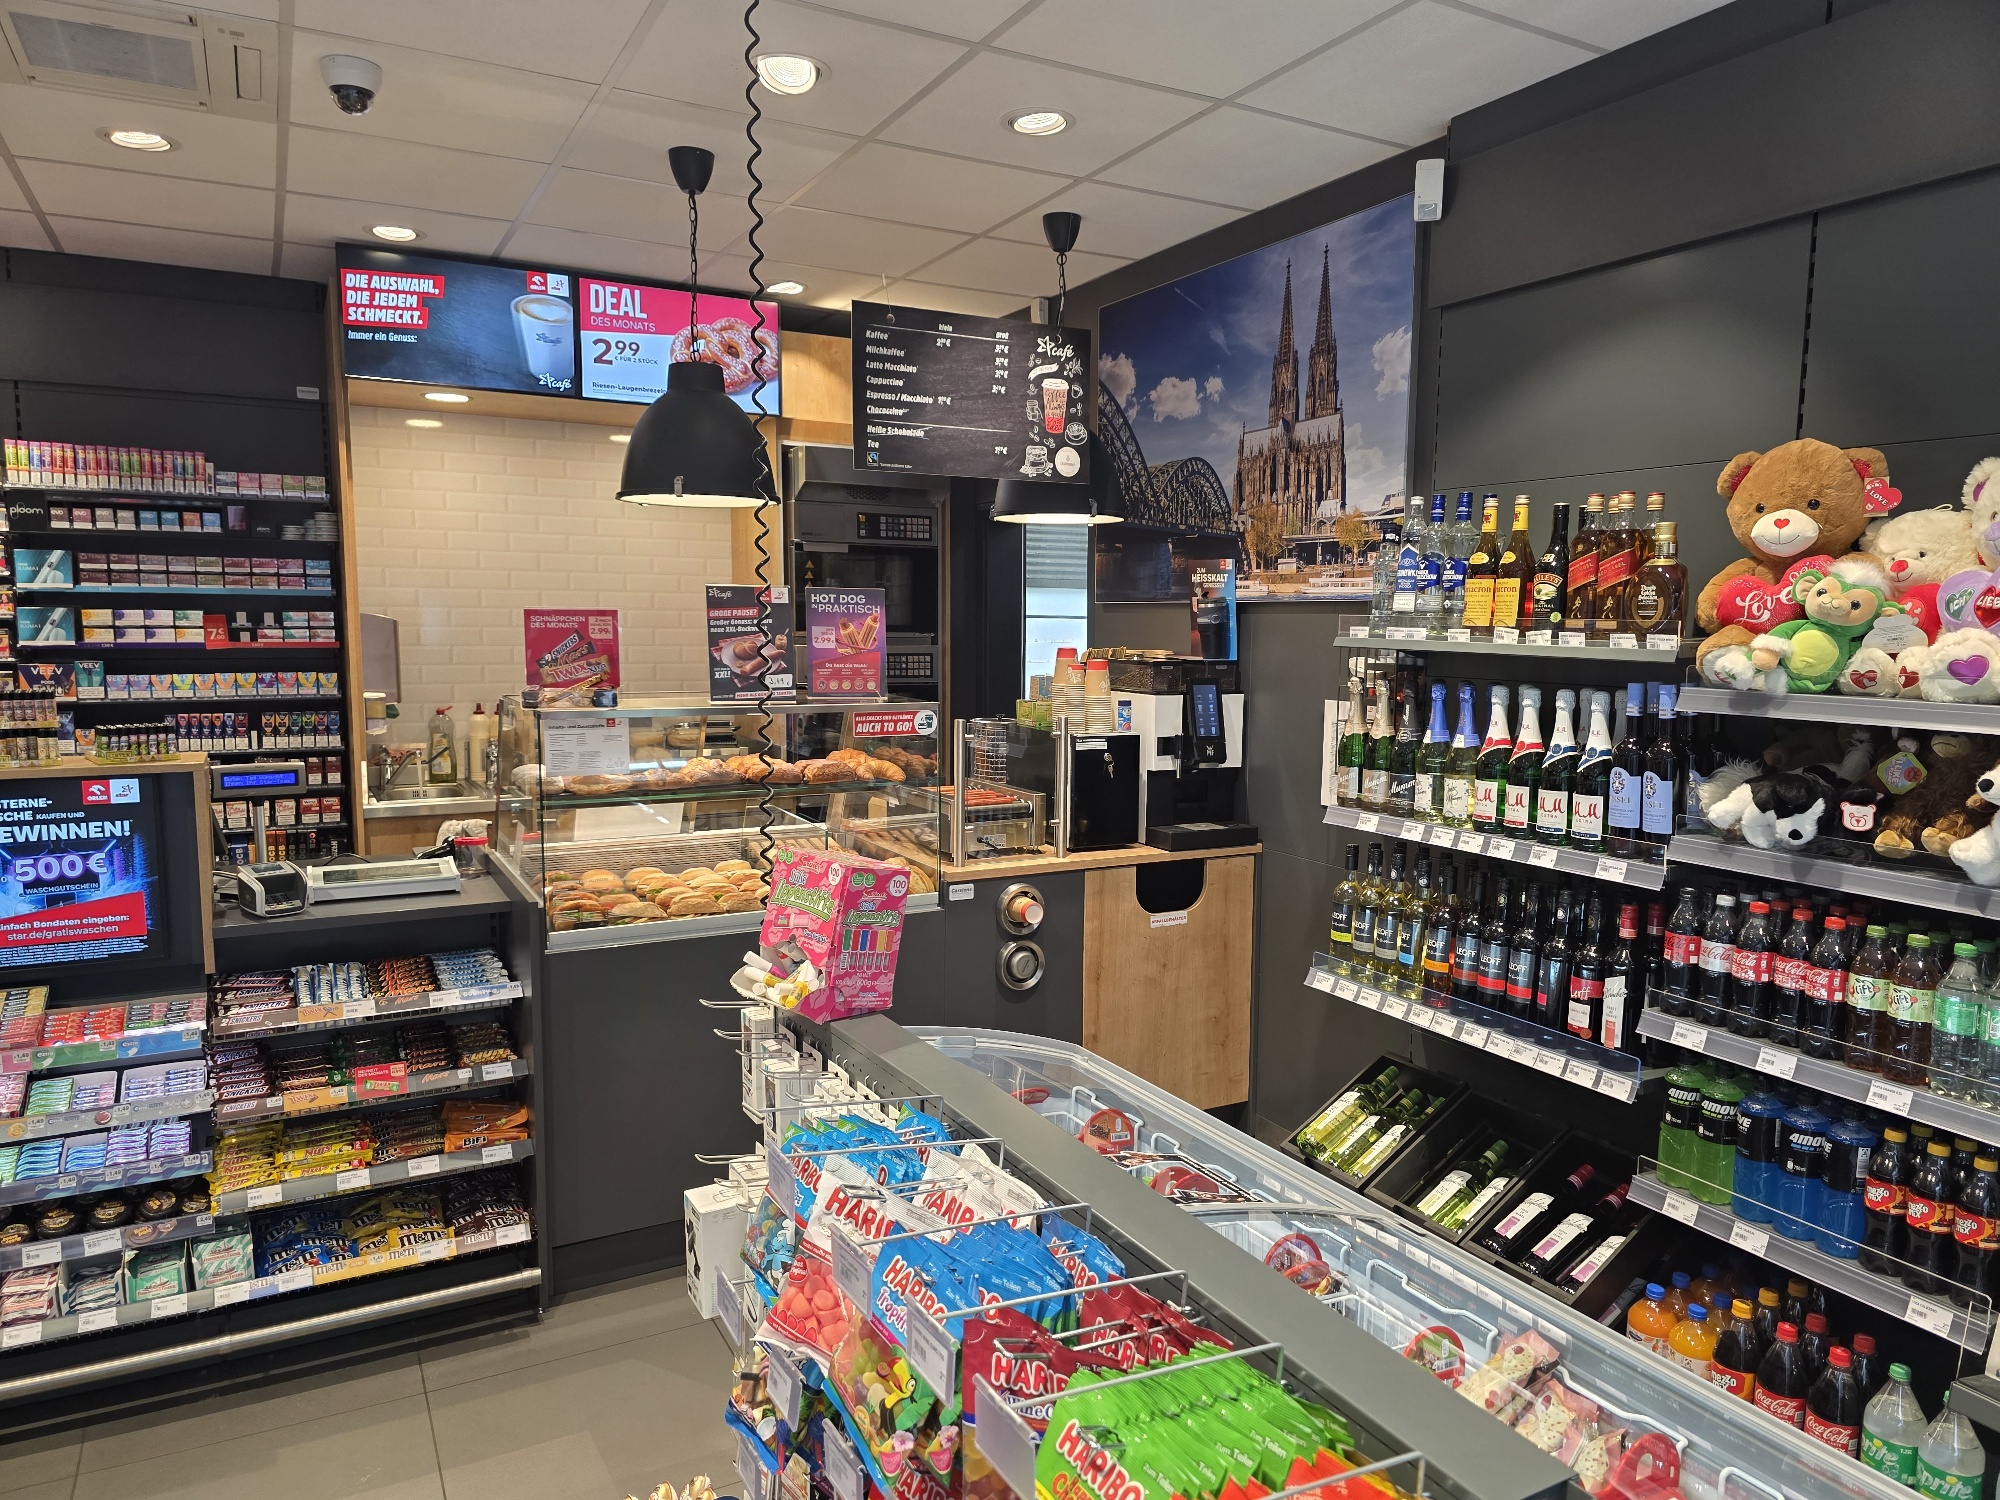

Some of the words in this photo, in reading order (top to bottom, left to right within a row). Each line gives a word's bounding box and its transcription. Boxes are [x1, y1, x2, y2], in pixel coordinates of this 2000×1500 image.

[346, 274, 368, 288] DIE
[371, 275, 440, 295] AUSWAHL,
[346, 290, 369, 305] DIE
[373, 292, 417, 308] JEDEM
[590, 284, 647, 319] DEAL
[348, 307, 423, 324] SCHMECKT.
[591, 316, 610, 326] DES
[613, 319, 655, 332] MONATS
[348, 330, 373, 341] Immer
[374, 332, 386, 341] ein
[389, 333, 417, 343] Genuss:
[866, 345, 904, 357] Milchkaffee
[1051, 344, 1074, 361] café
[638, 357, 658, 365] STÜCK
[866, 360, 883, 370] Latte
[884, 362, 917, 373] Macchiato
[551, 378, 572, 391] café
[866, 375, 903, 387] Cappuccino
[866, 390, 895, 400] Espresso
[901, 394, 933, 404] Macchiato
[867, 425, 886, 434] Heiße
[868, 440, 879, 449] Tee
[1868, 490, 1890, 507] LOVE
[10, 502, 44, 519] ploom
[1191, 574, 1228, 582] HEISSKALT
[718, 591, 732, 599] café
[811, 594, 836, 603] HOT
[840, 594, 866, 603] DOG
[818, 604, 880, 614] PRAKTISCH
[1734, 585, 1795, 623] Love
[1950, 596, 1966, 613] ICH
[553, 635, 578, 658] SNICKERS
[856, 723, 881, 733] AUCH
[883, 723, 895, 732] TO
[896, 722, 912, 731] GO!
[1390, 779, 1416, 794] Mumm
[236, 848, 245, 864] OCB
[25, 882, 98, 894] WASCHGUTSCHEIN
[892, 879, 906, 889] 100
[770, 879, 836, 915] Lippenstifte
[34, 918, 81, 928] Bondaten
[83, 915, 129, 924] eingeben:
[7, 924, 119, 941] star.de/gratiswaschen
[1427, 939, 1445, 948] LEOFF
[1457, 947, 1477, 957] LEOFF
[1480, 953, 1501, 965] LEOFF
[1509, 961, 1527, 973] LEOFF
[239, 985, 283, 996] SNICKERS
[463, 989, 489, 997] BOUNTY
[395, 995, 419, 1005] Mars
[229, 1014, 262, 1025] SNICKERS
[422, 1071, 449, 1083] Mars
[224, 1087, 266, 1097] SNICKERS
[1701, 1099, 1739, 1115] 4mov
[463, 1136, 487, 1147] BiFi
[304, 1145, 332, 1157] NUTS
[1867, 1185, 1889, 1197] mezzo
[1868, 1192, 1881, 1202] mix
[1955, 1216, 1977, 1229] mezzo
[1956, 1225, 1970, 1235] mix
[398, 1229, 447, 1248] m&m's
[465, 1231, 494, 1244] m&m's
[316, 1261, 347, 1275] m&m's
[991, 1276, 1002, 1285] Zum
[1003, 1279, 1022, 1293] Teilen
[1755, 1388, 1798, 1415] Coca-Cola
[1805, 1415, 1850, 1445] Coca-Cola
[1250, 1429, 1263, 1444] Zum
[1264, 1437, 1287, 1459] Teilen
[1056, 1418, 1144, 1500] HARIBO
[1215, 1442, 1230, 1455] Zum
[1234, 1449, 1254, 1468] Teilen
[1143, 1463, 1156, 1476] Zum
[1156, 1474, 1174, 1493] Teilen
[1916, 1461, 1974, 1499] Sprite
